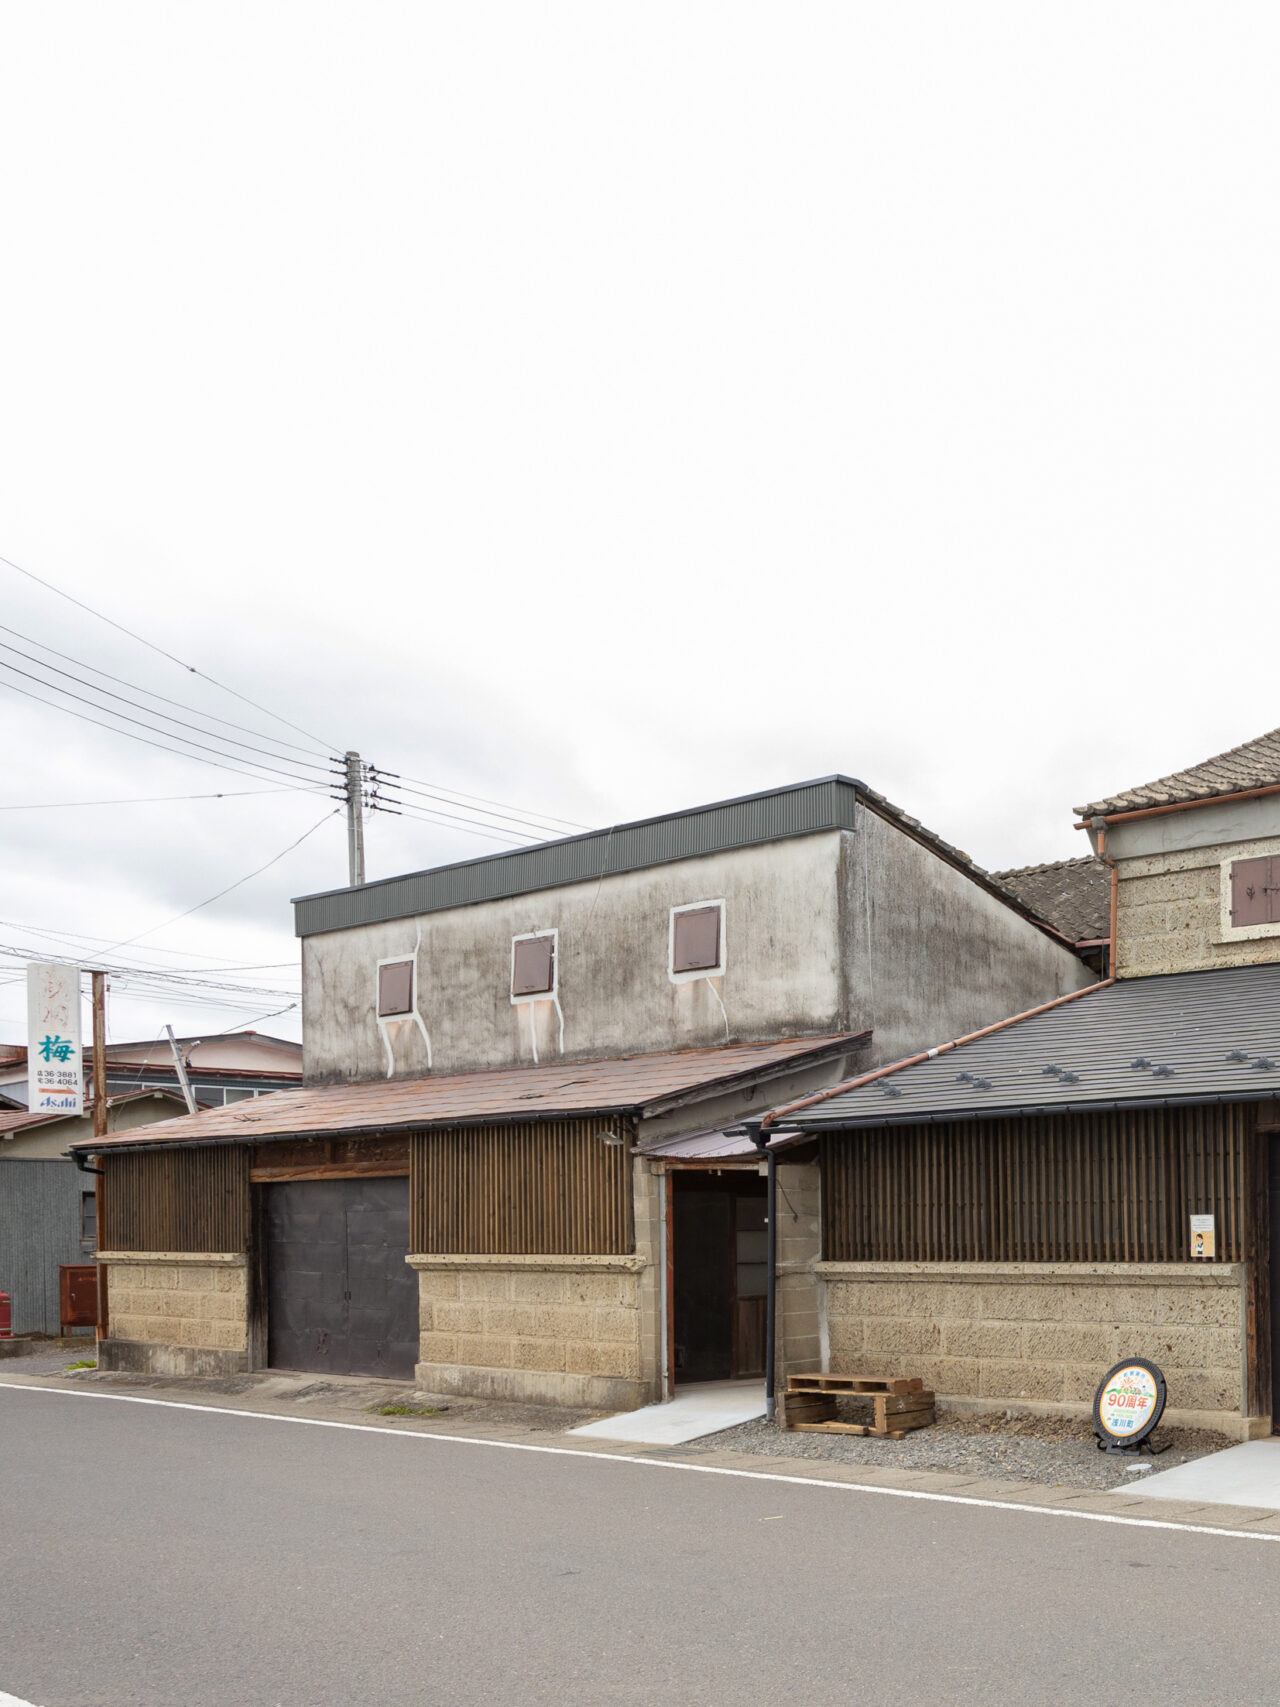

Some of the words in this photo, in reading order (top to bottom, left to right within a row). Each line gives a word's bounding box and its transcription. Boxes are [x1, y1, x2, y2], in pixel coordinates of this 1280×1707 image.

[38, 1035, 76, 1062] 梅
[40, 1096, 76, 1108] Asahi
[1107, 1393, 1148, 1409] 90周年
